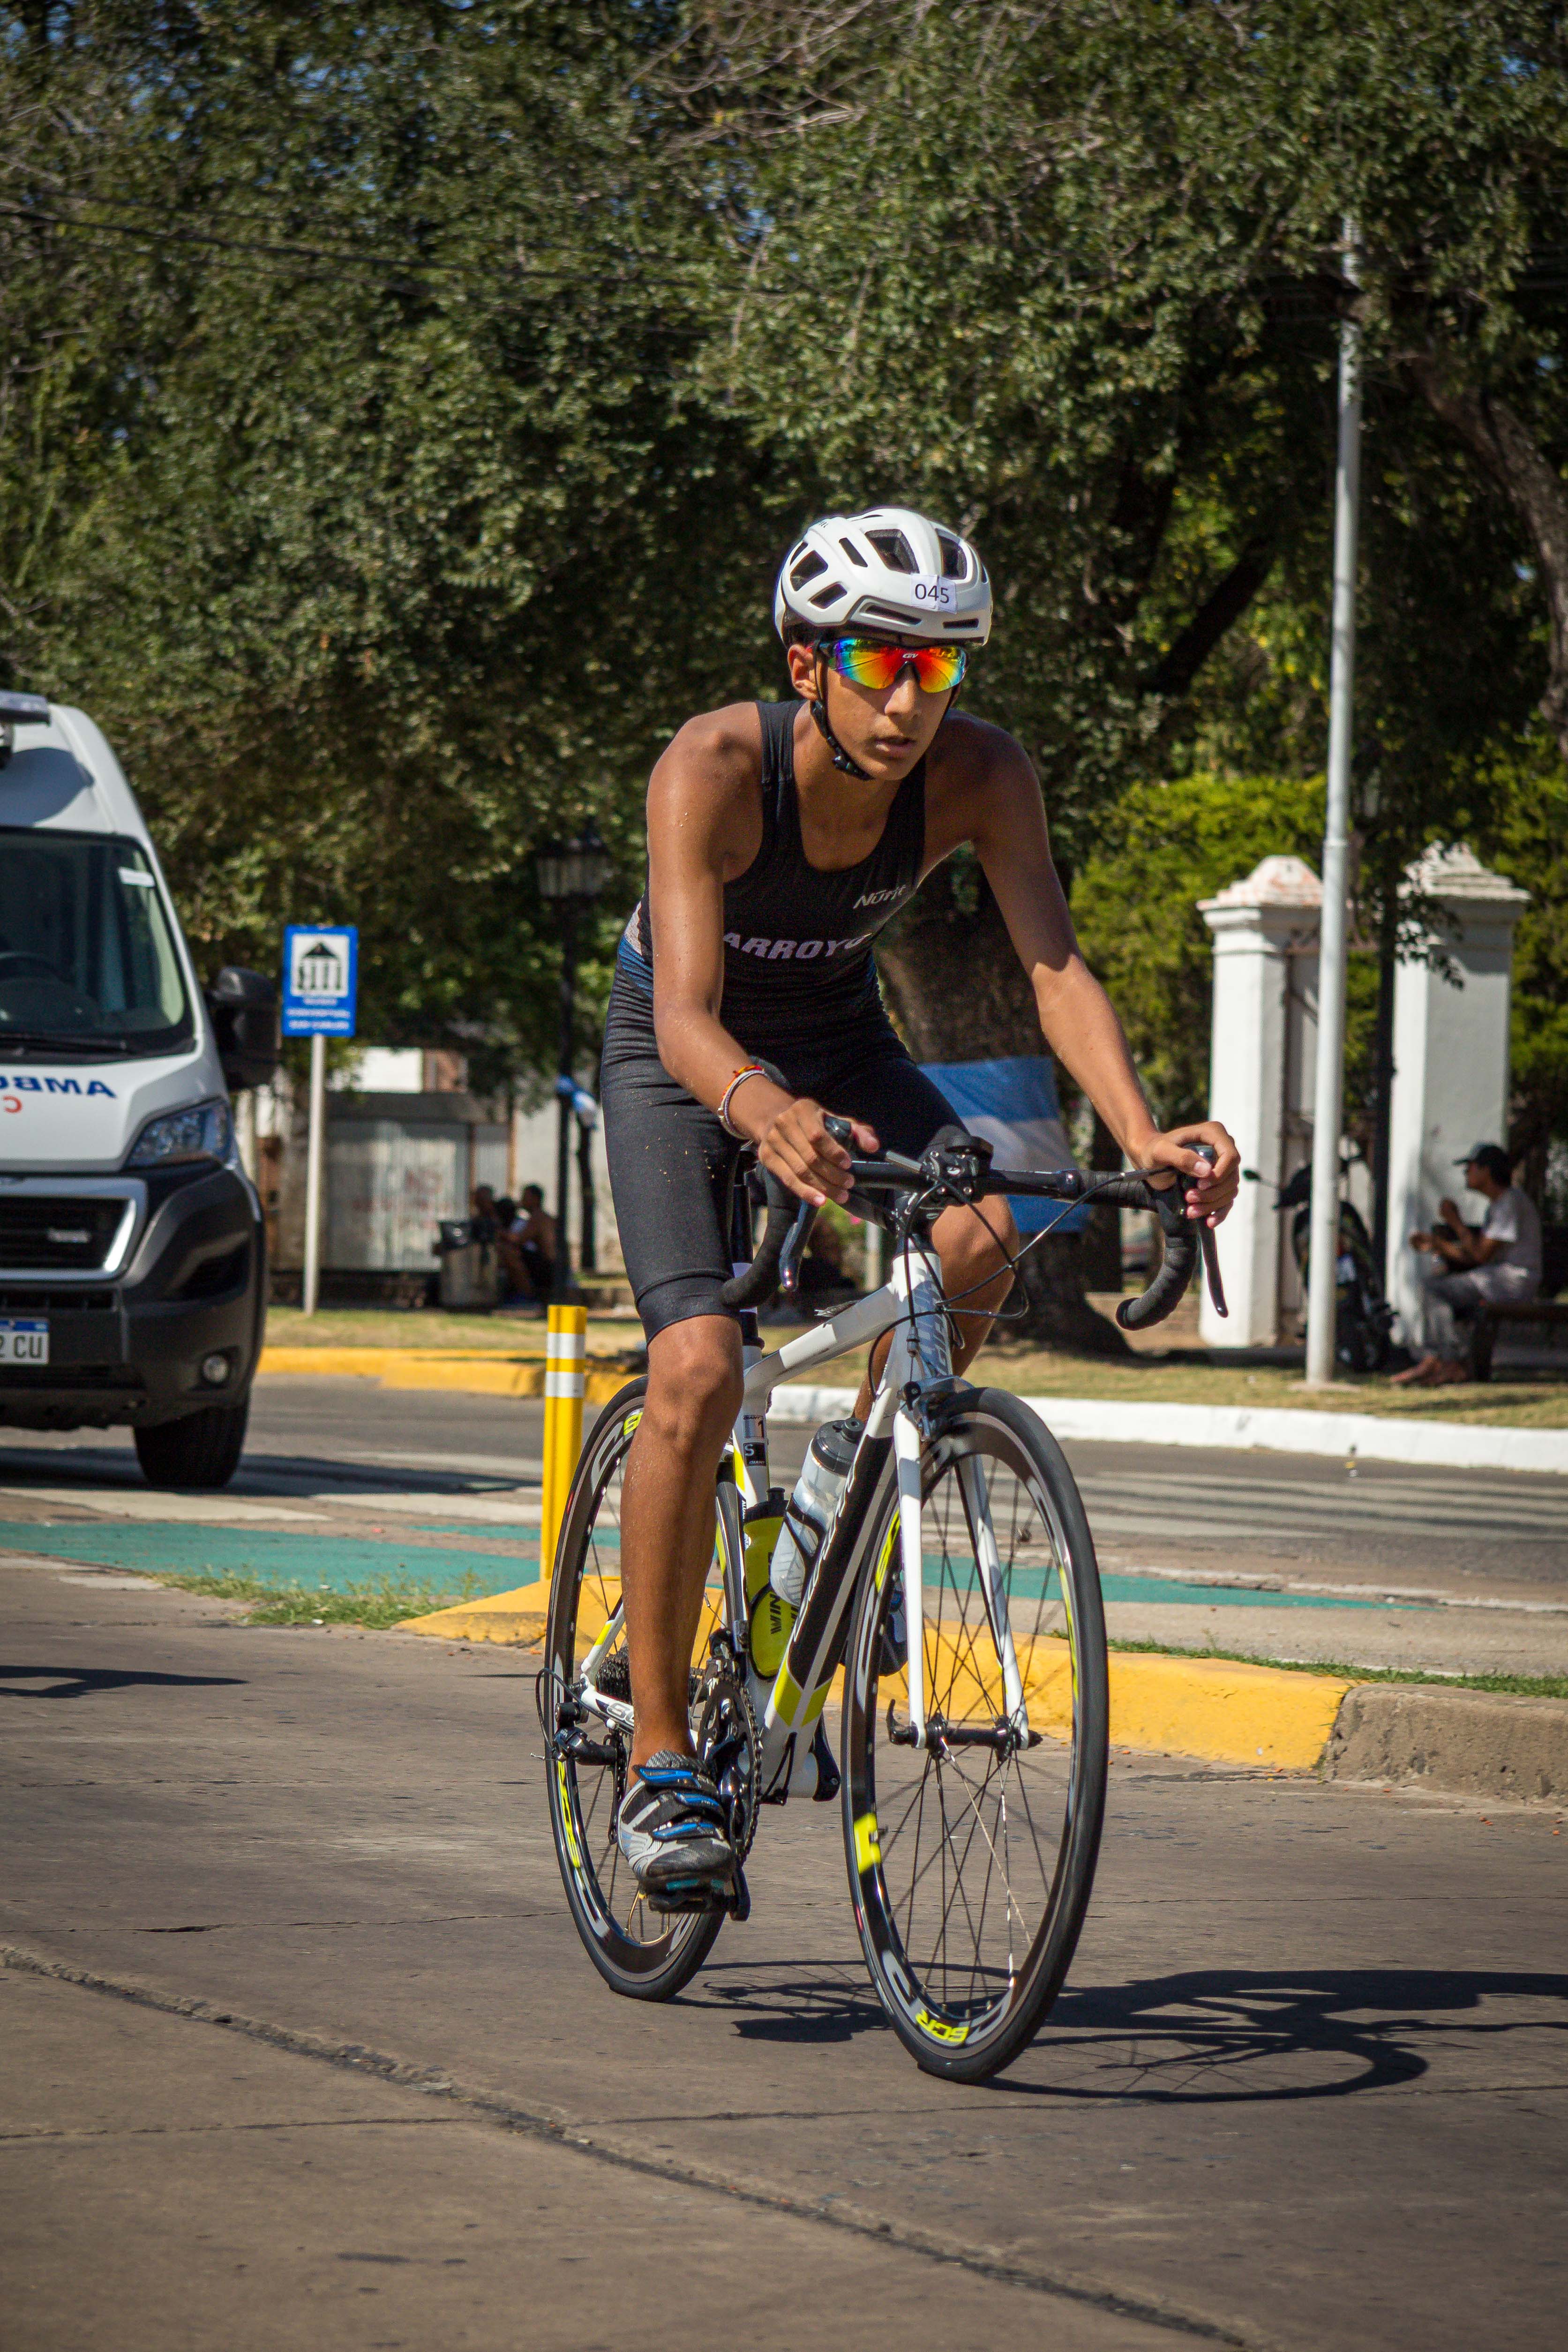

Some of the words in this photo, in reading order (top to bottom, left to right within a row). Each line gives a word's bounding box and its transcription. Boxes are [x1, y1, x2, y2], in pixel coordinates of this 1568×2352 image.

[915, 584, 949, 603] 045
[14, 1335, 43, 1358] CU
[744, 1444, 755, 1456] S
